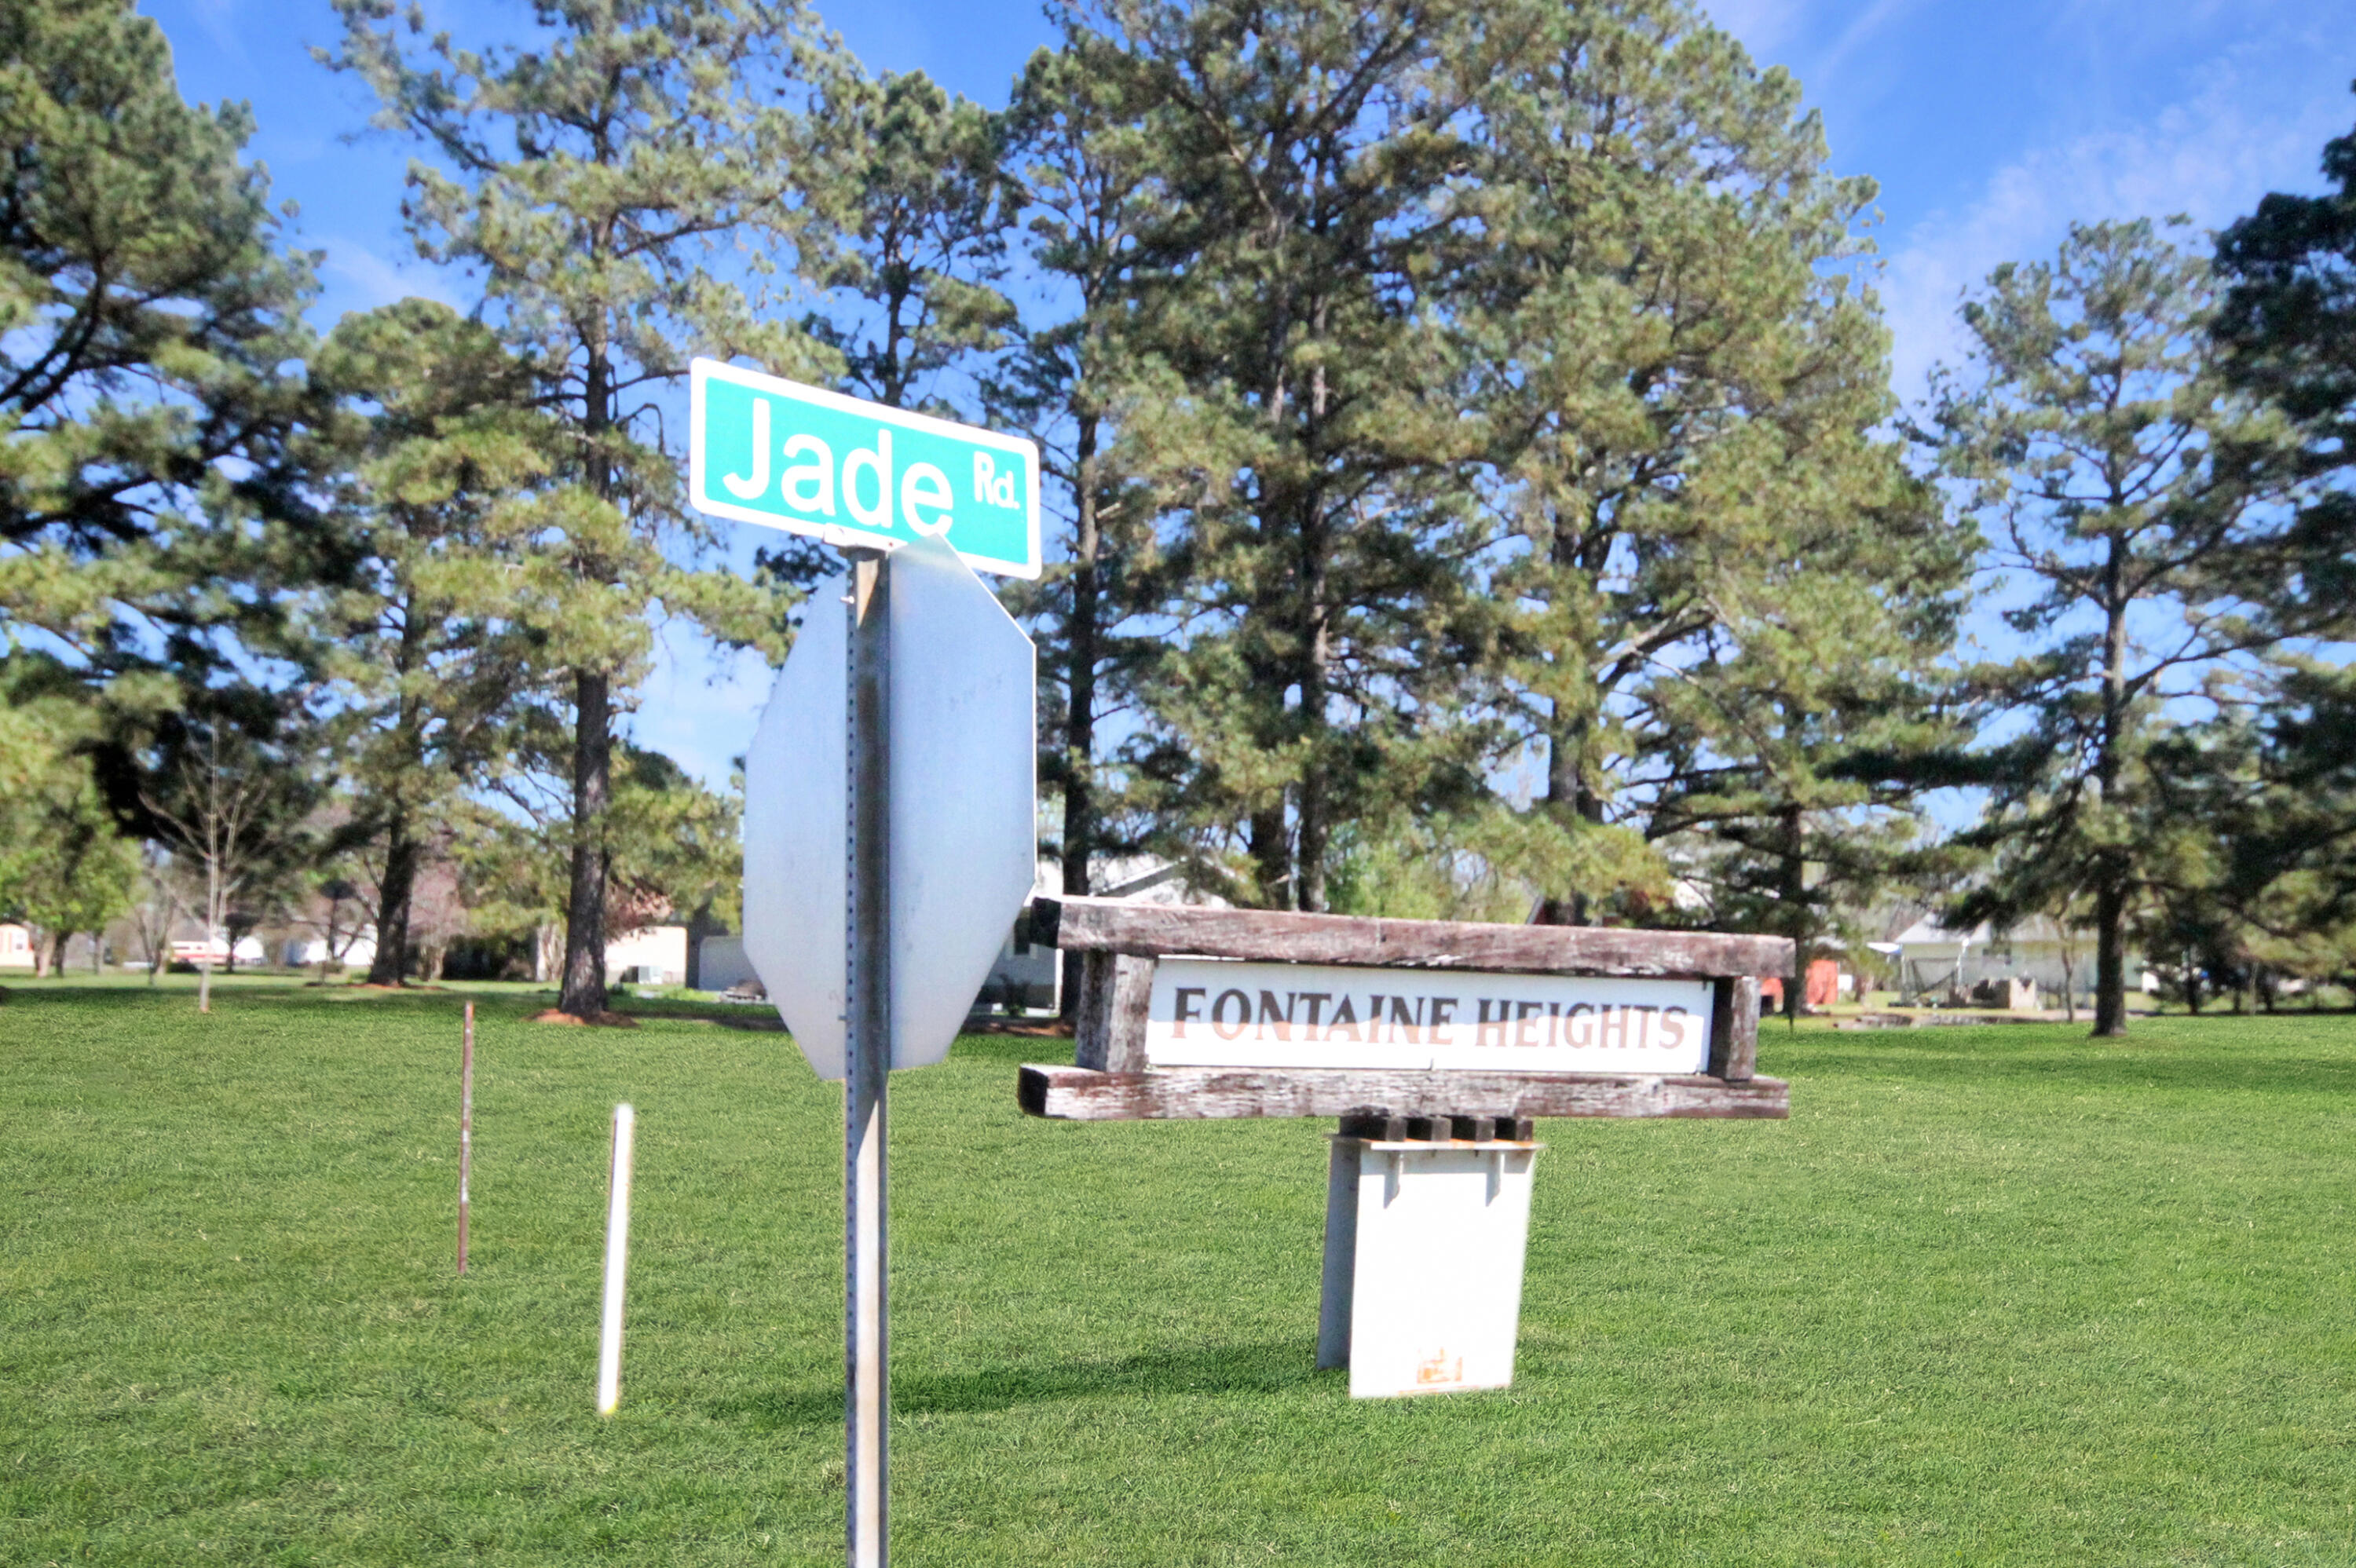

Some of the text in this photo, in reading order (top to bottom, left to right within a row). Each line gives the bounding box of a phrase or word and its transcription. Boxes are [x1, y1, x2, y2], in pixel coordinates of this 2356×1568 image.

[723, 398, 1020, 537] Jade Rd.
[1170, 986, 1689, 1050] FONTAINE HEIGHTS
